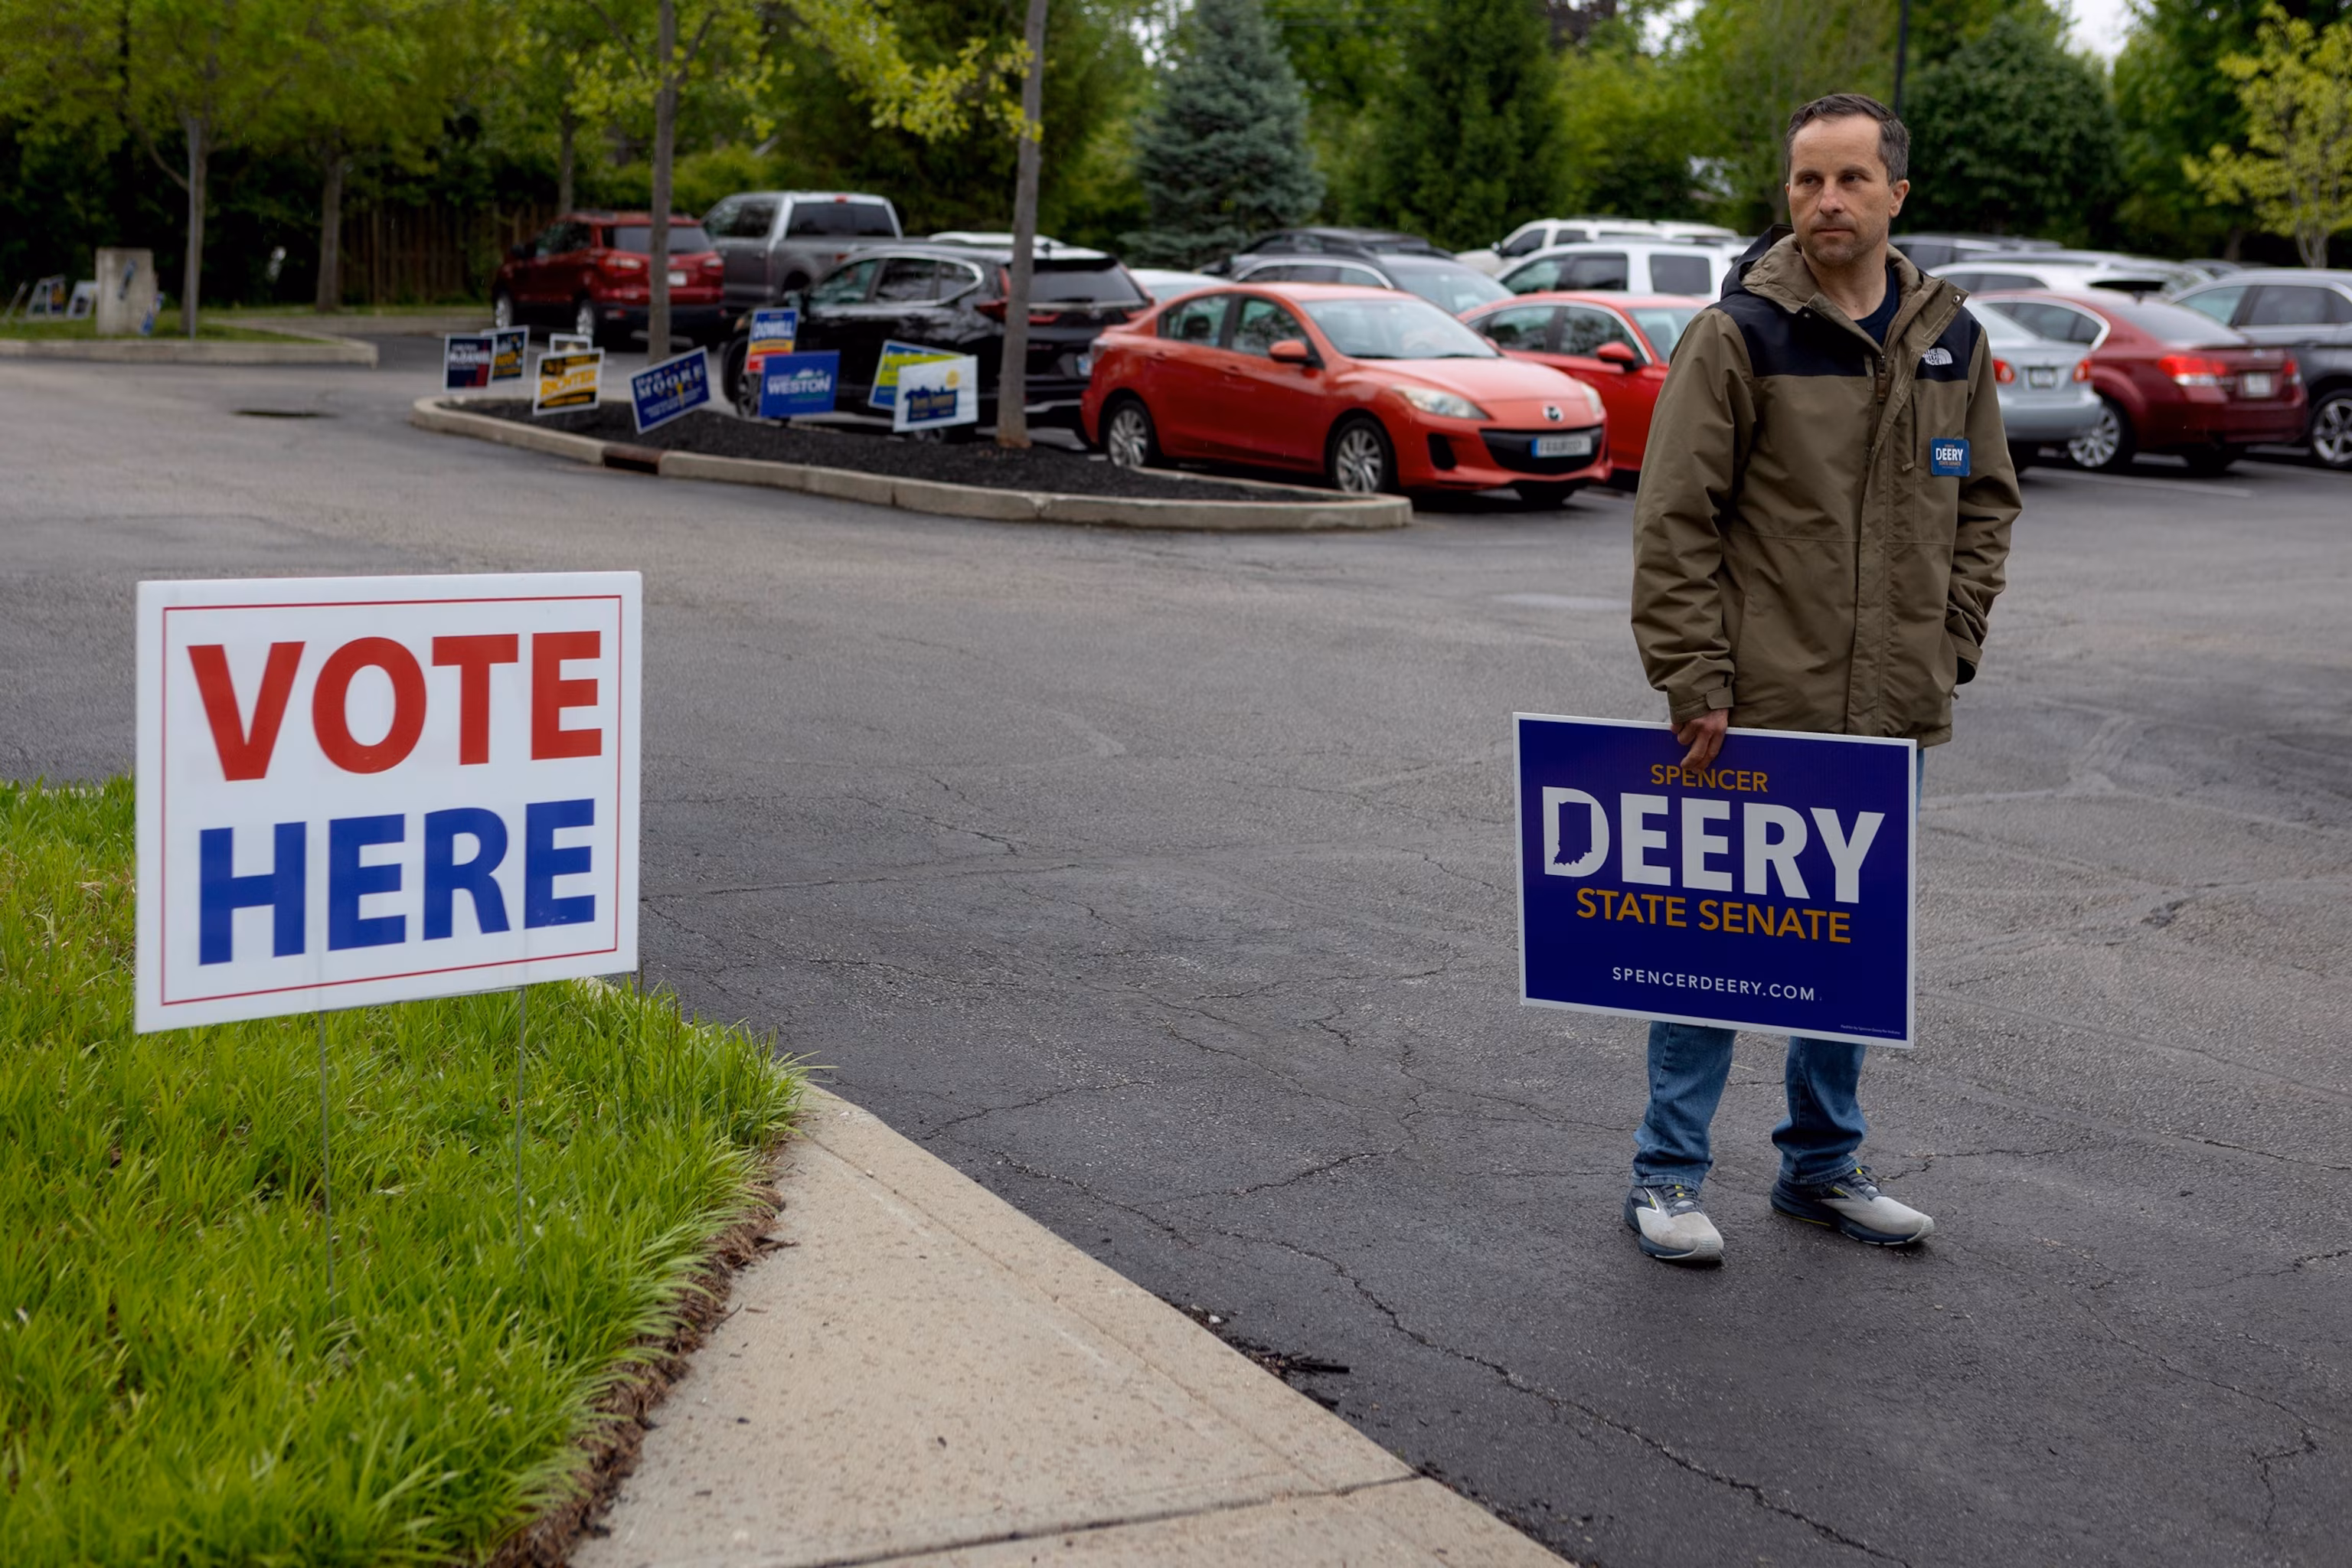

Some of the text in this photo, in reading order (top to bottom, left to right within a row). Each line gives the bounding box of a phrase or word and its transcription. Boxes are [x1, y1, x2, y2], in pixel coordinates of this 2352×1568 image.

[767, 373, 832, 395] WESTON
[1936, 447, 1963, 461] DEERY
[188, 630, 603, 782] VOTE
[1651, 764, 1769, 792] SPENCER
[1542, 786, 1885, 904] DEERY
[198, 798, 596, 966] HERE
[1576, 887, 1851, 944] STATE SENATE
[1612, 966, 1815, 1001] SPENCERDEERY.COM
